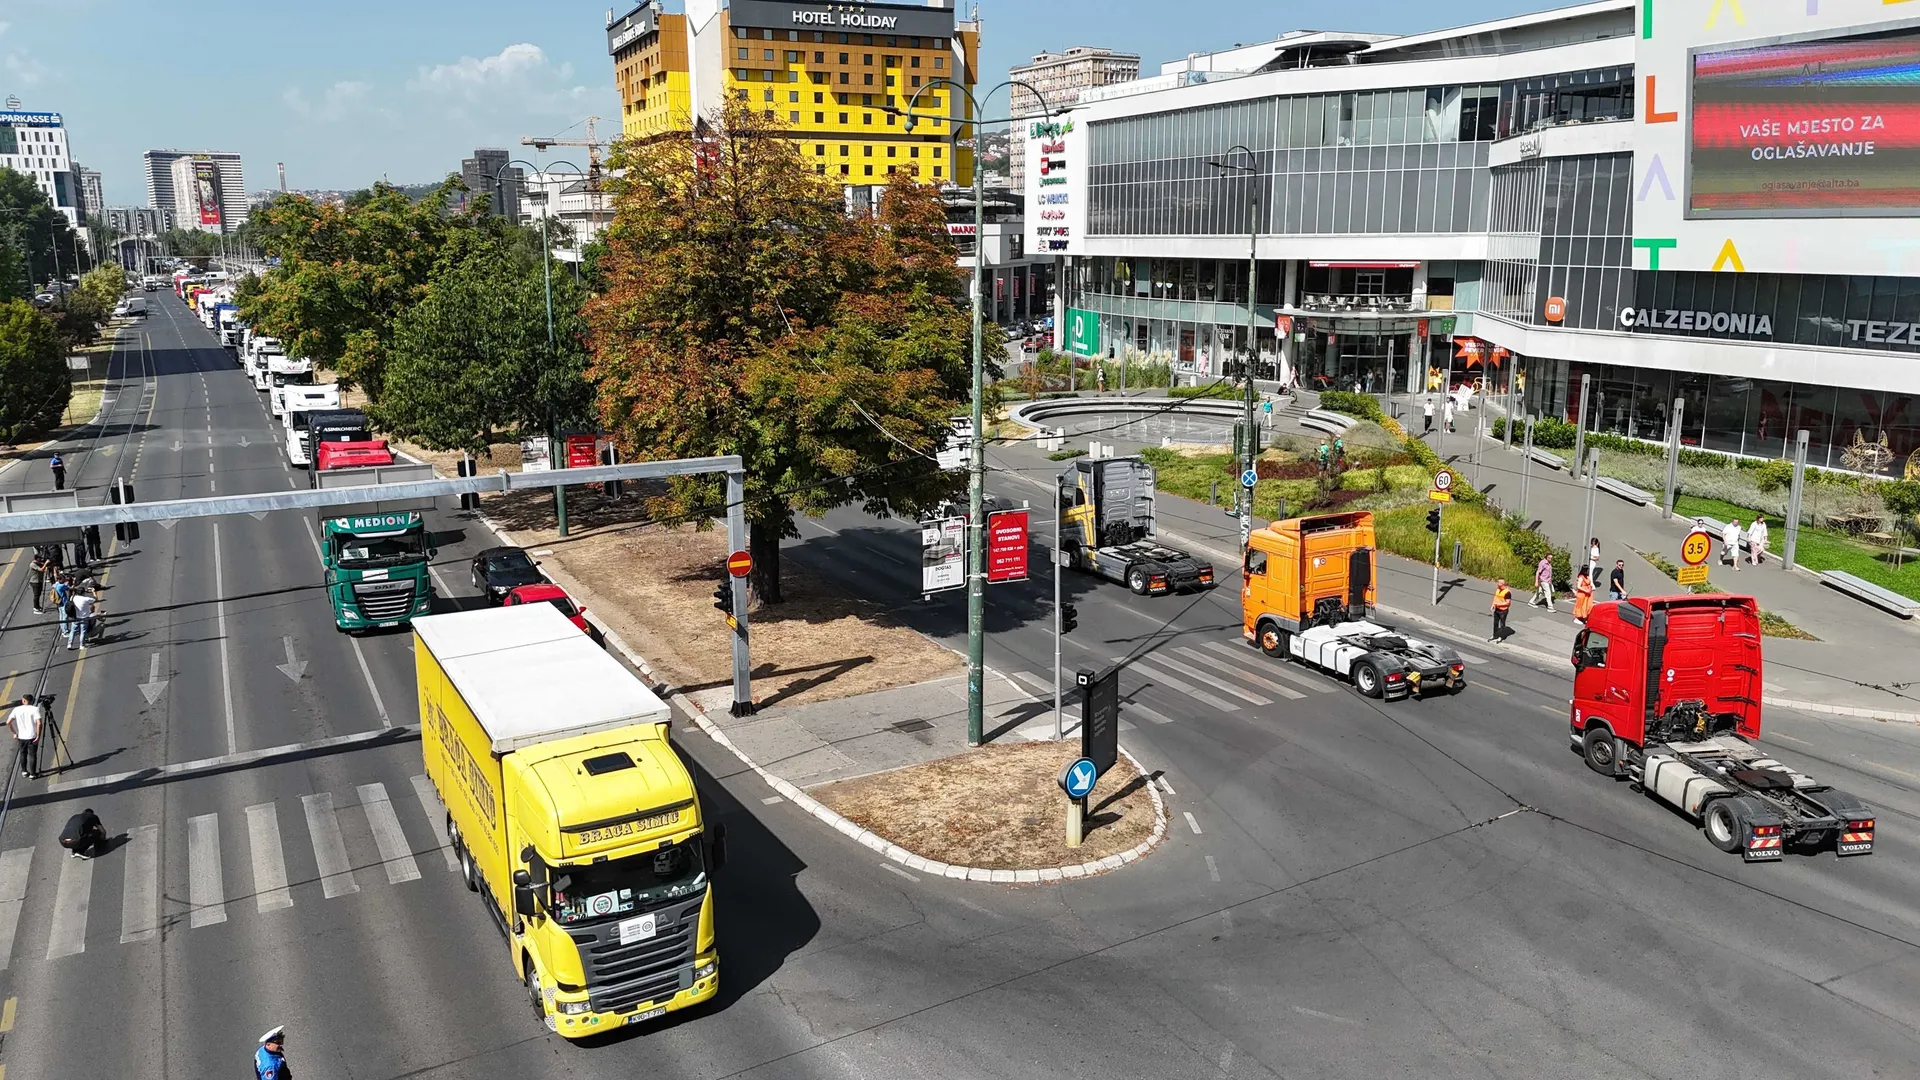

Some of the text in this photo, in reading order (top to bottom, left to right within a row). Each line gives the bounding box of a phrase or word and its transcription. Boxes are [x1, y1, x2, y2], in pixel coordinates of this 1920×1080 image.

[792, 11, 897, 29] HOTEL HOLIDAY
[0, 114, 50, 124] PARKASSE
[1740, 115, 1885, 138] VAŠE MJESTO ZA
[1751, 141, 1875, 161] OGLAŠAVANJE
[1762, 179, 1860, 192] oglasavanje@alta.ba
[1620, 307, 1773, 336] CALZEDONIA
[1438, 475, 1449, 486] 60
[354, 516, 405, 529] MEDION
[374, 583, 396, 591] DAF
[1748, 849, 1780, 857] VOLVO
[1841, 843, 1871, 851] VOLVO
